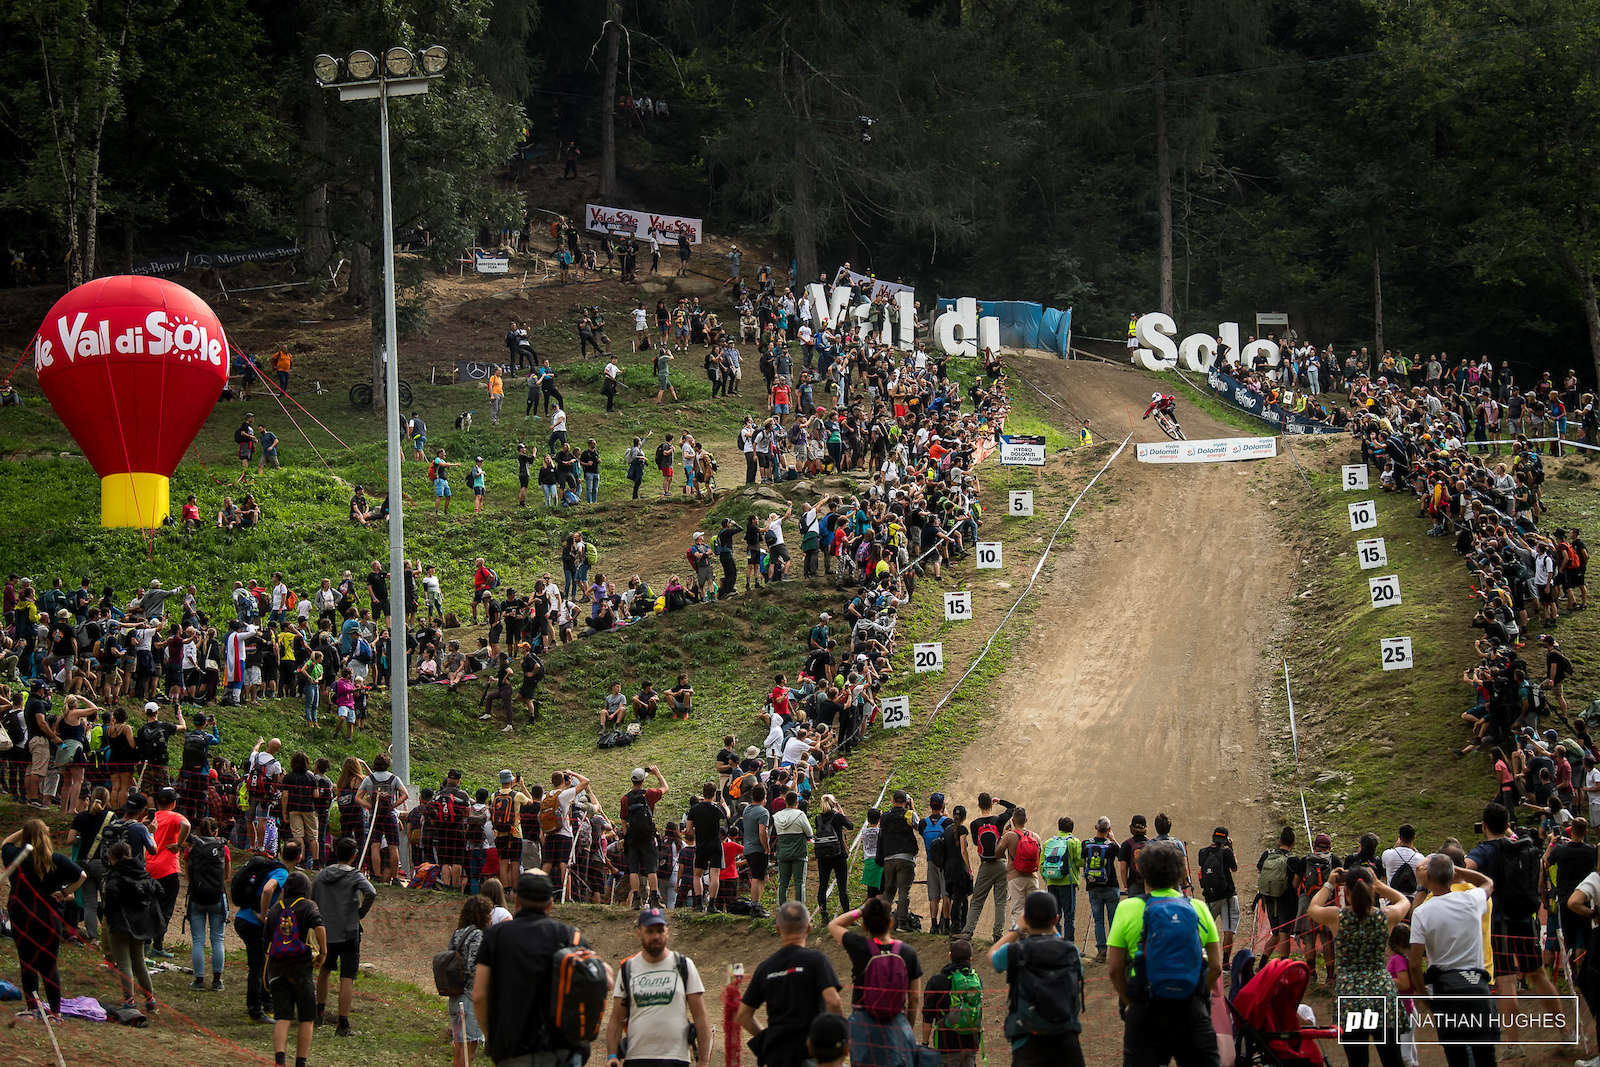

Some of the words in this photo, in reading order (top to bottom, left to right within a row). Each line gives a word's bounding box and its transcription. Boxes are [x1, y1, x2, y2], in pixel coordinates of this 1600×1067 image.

[591, 207, 607, 223] Val
[616, 211, 638, 225] Sole
[649, 215, 665, 230] Val
[665, 223, 674, 231] di
[57, 312, 111, 363] Val
[115, 327, 144, 354] di
[145, 311, 222, 365] Sole
[1197, 447, 1227, 455] Dolomiti
[1243, 443, 1273, 451] Dolomiti
[1347, 472, 1358, 486] 5
[1014, 498, 1023, 511] 5
[1352, 510, 1369, 524] 10
[979, 550, 995, 563] 10
[1361, 547, 1380, 562] 15
[1372, 585, 1394, 602] 20
[947, 600, 965, 614] 15
[916, 651, 937, 667] 20
[1383, 646, 1405, 663] 25
[883, 706, 904, 723] 25
[639, 976, 671, 986] Camp
